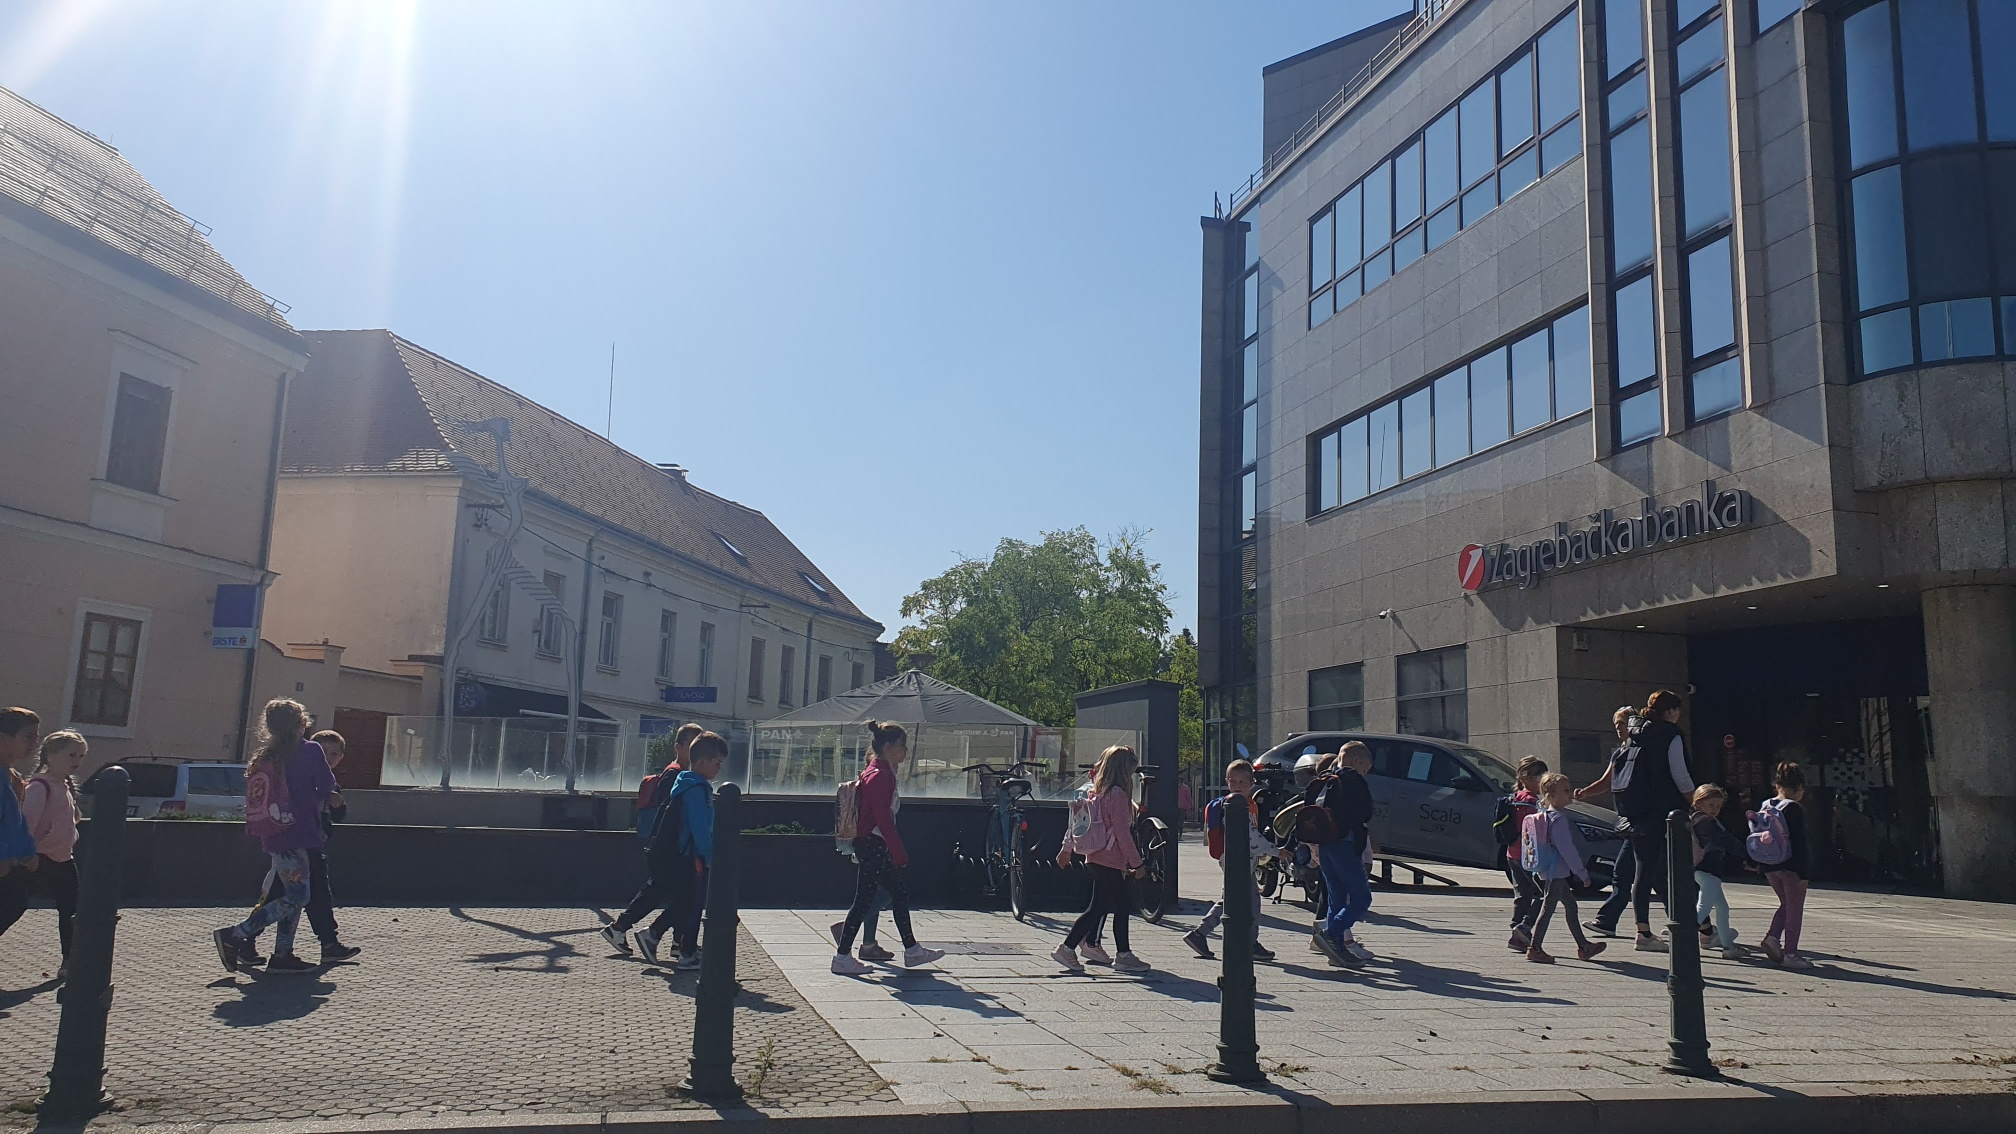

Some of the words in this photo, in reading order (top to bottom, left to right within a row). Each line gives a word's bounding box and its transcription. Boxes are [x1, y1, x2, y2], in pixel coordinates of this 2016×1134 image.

[1489, 508, 1635, 590] Zagrebačka
[1640, 479, 1743, 549] banka
[212, 636, 238, 646] ERSTE
[760, 729, 792, 740] PAN
[1419, 803, 1462, 824] Scala
